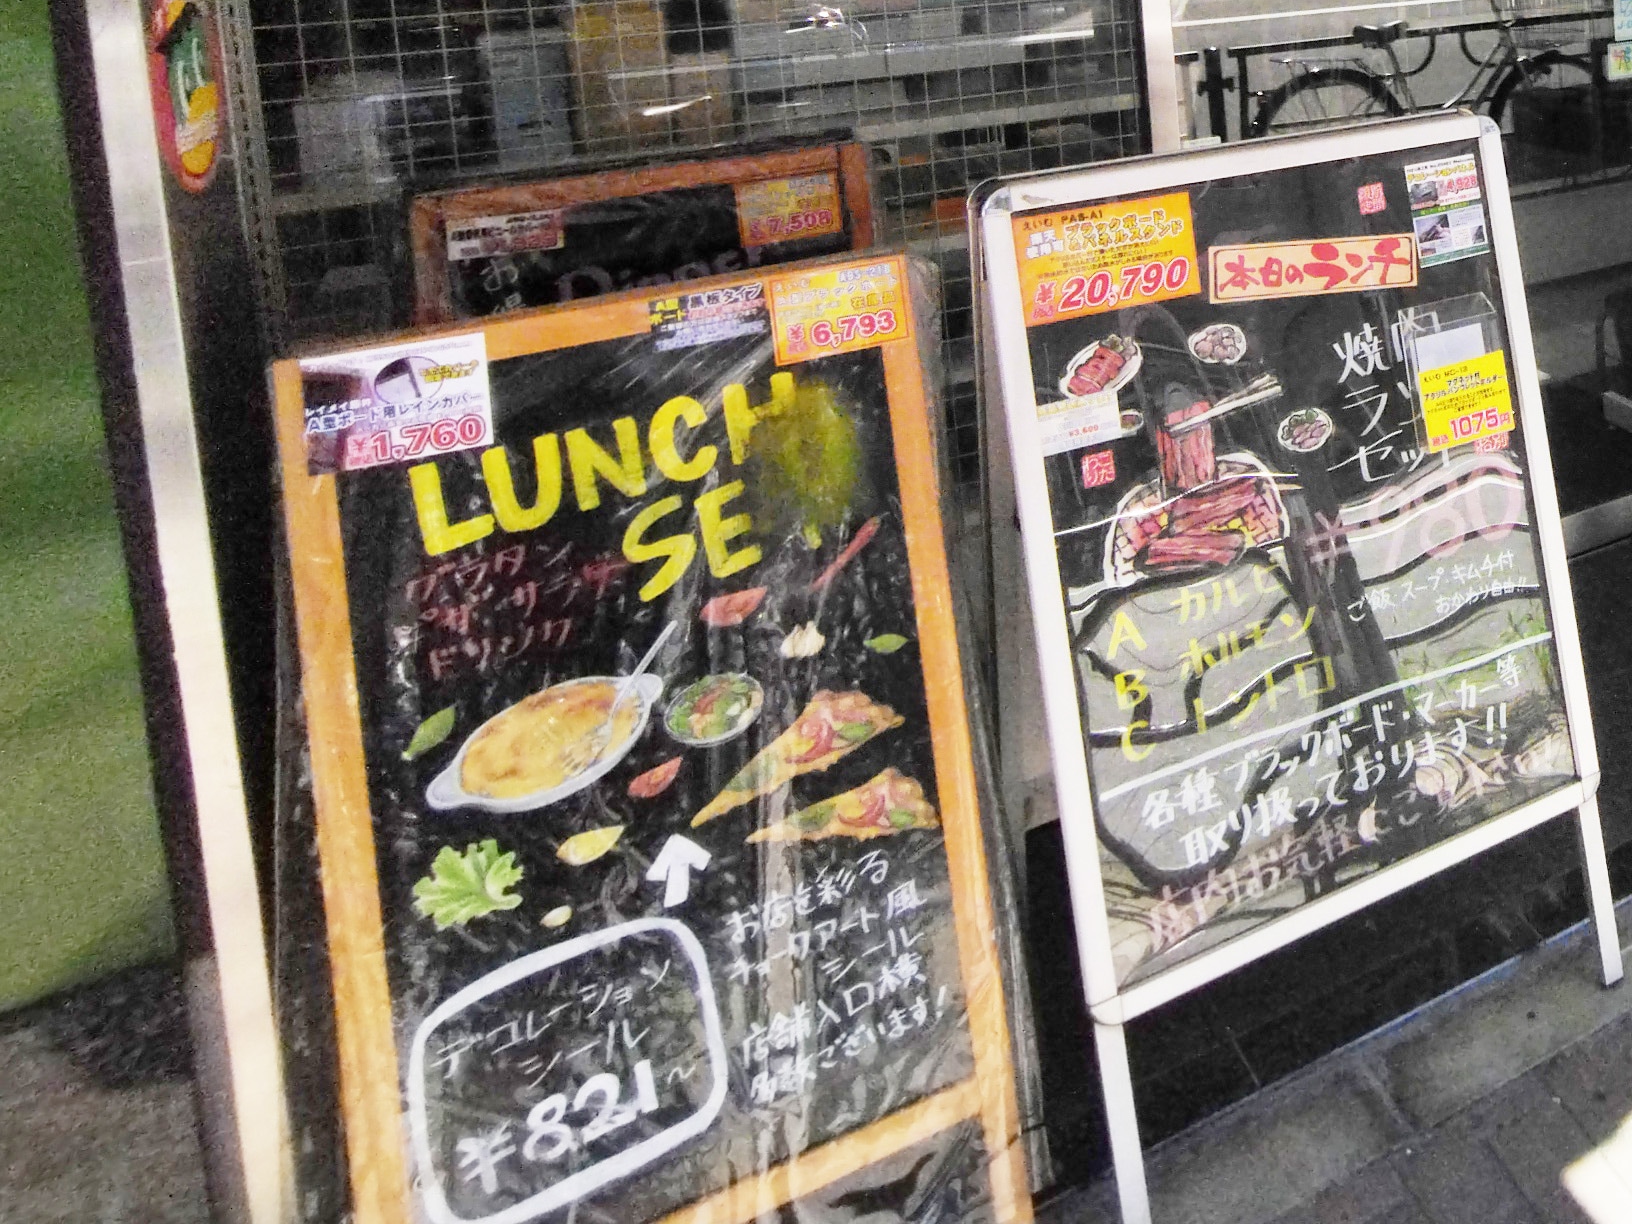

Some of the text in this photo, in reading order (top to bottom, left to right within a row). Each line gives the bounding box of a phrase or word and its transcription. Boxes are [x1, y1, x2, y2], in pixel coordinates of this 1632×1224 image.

[1065, 208, 1166, 238] ブラックボード
[1057, 256, 1190, 313] 20,790
[1219, 237, 1412, 292] 本日のランチ
[811, 309, 897, 348] 6,793
[371, 413, 486, 462] 1,760
[1449, 407, 1512, 441] 1075円
[409, 372, 796, 557] LUNCH
[1107, 611, 1148, 661] A
[1114, 669, 1149, 710] B
[1122, 720, 1157, 762] C
[726, 849, 890, 944] お店を彩る
[820, 926, 924, 984] シール
[524, 1020, 650, 1089] シール
